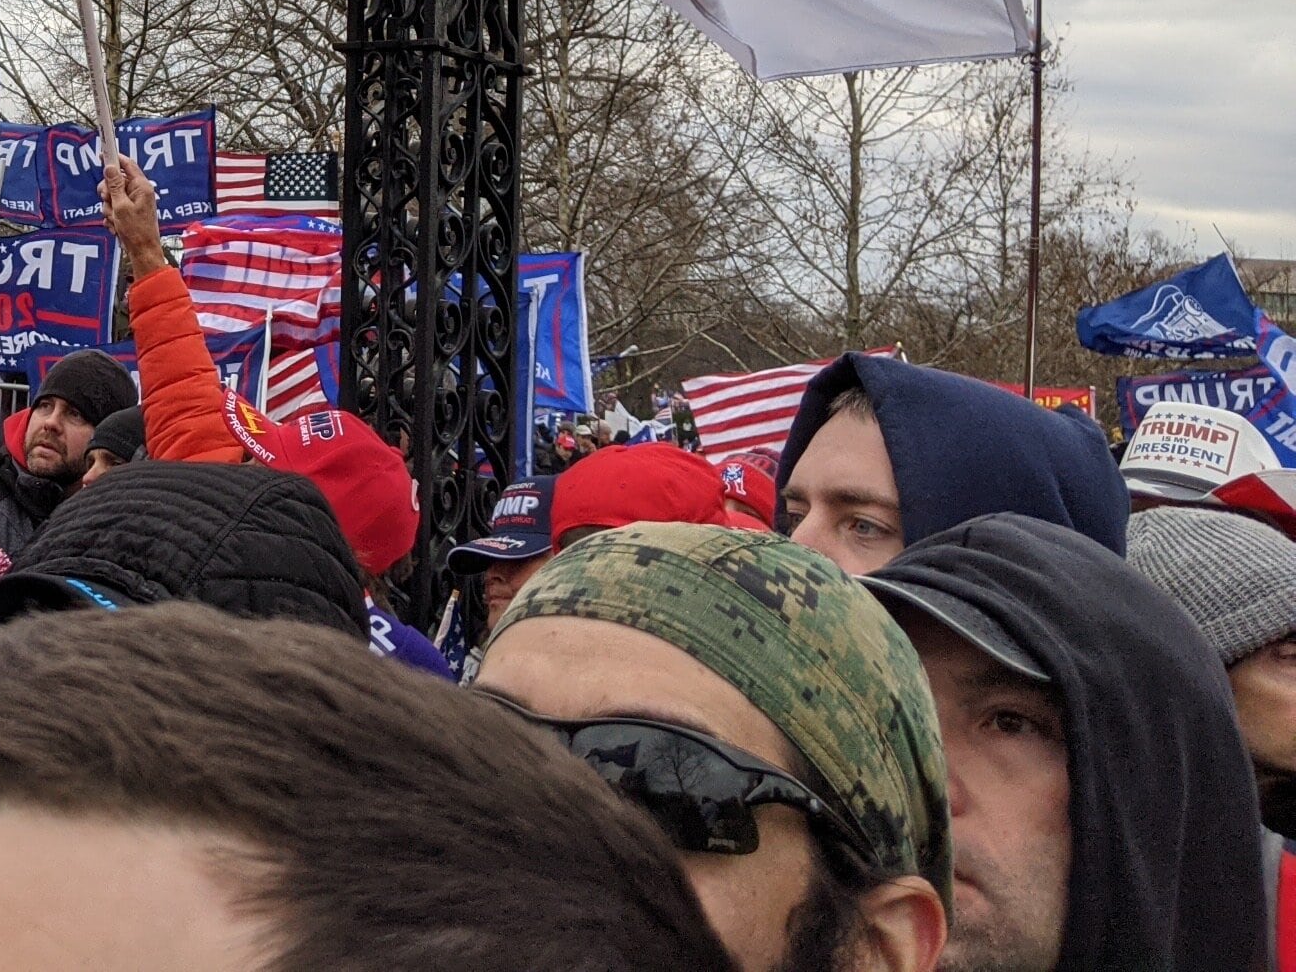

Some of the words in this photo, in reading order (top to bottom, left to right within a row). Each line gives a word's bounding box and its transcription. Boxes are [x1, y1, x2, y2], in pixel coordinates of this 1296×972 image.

[226, 412, 276, 463] PRESIDENT
[1141, 421, 1229, 444] TRUMP
[1173, 436, 1190, 444] MY
[1133, 442, 1225, 465] PRESIDENT
